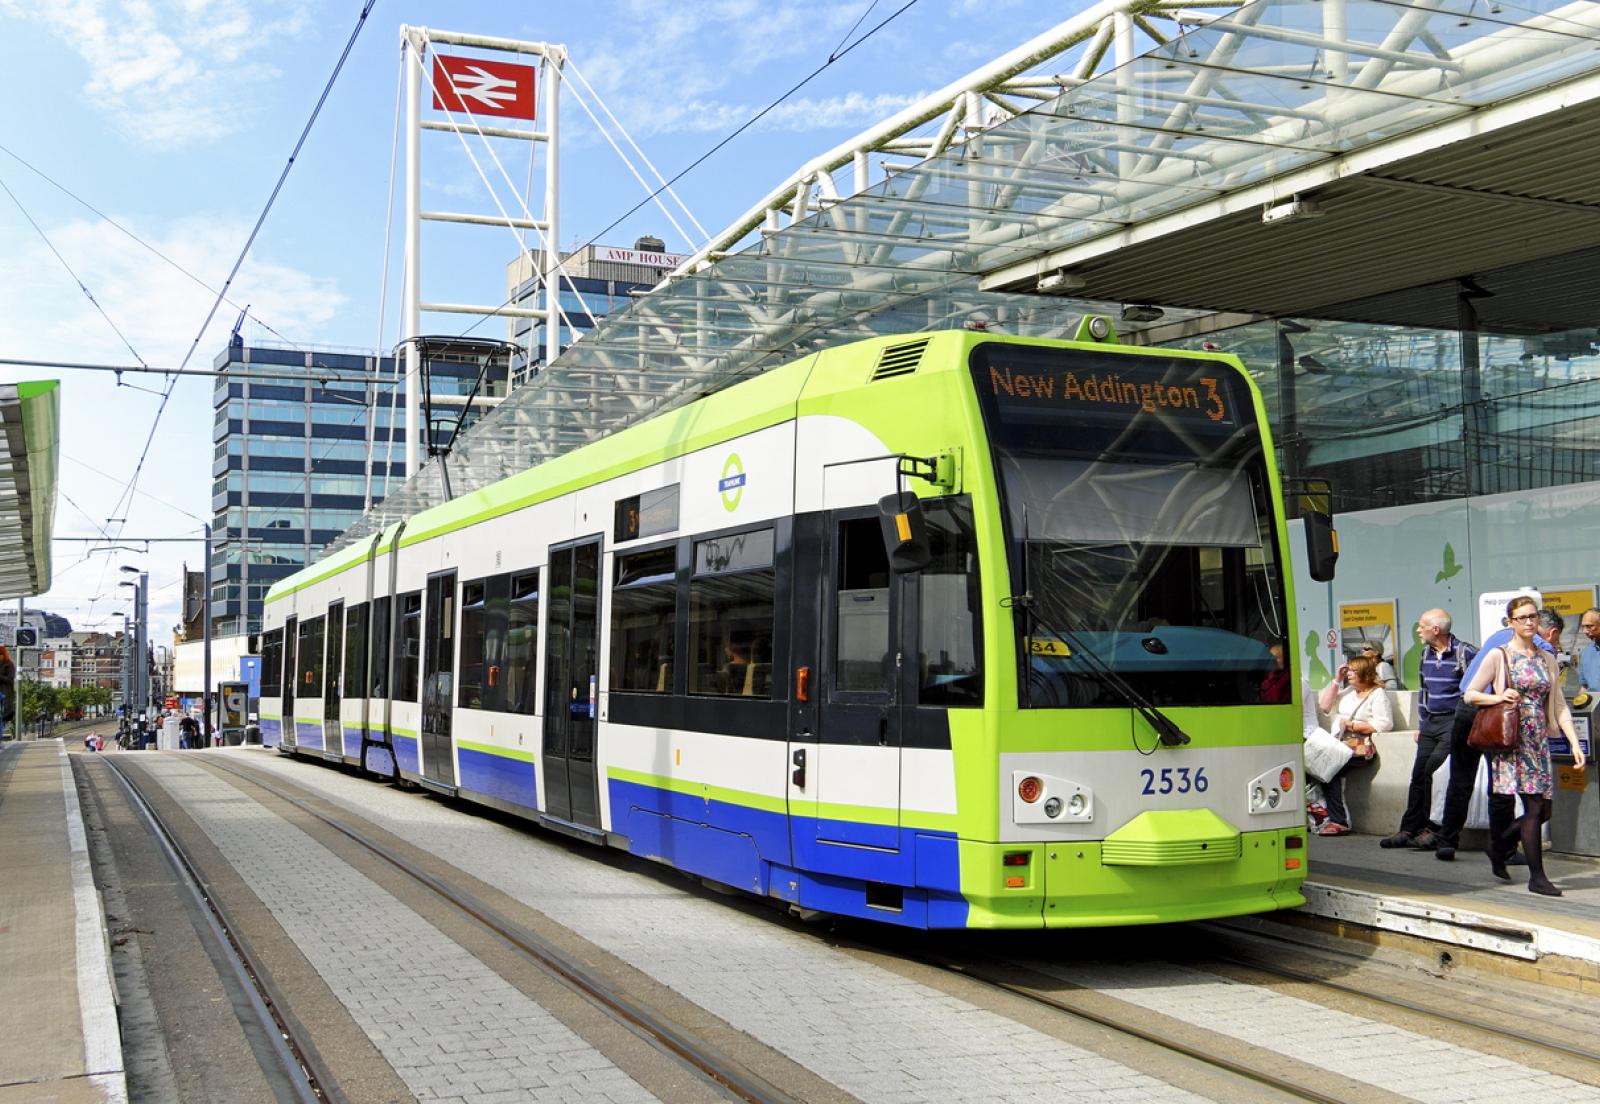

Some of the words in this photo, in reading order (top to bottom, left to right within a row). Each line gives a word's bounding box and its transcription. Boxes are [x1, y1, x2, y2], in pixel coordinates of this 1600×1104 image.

[607, 249, 634, 261] AMP
[640, 253, 680, 267] HOUSE
[989, 366, 1054, 399] New
[1064, 371, 1200, 413] Addington
[1200, 377, 1225, 421] 3
[1031, 642, 1056, 653] 34
[1141, 767, 1208, 795] 2536
